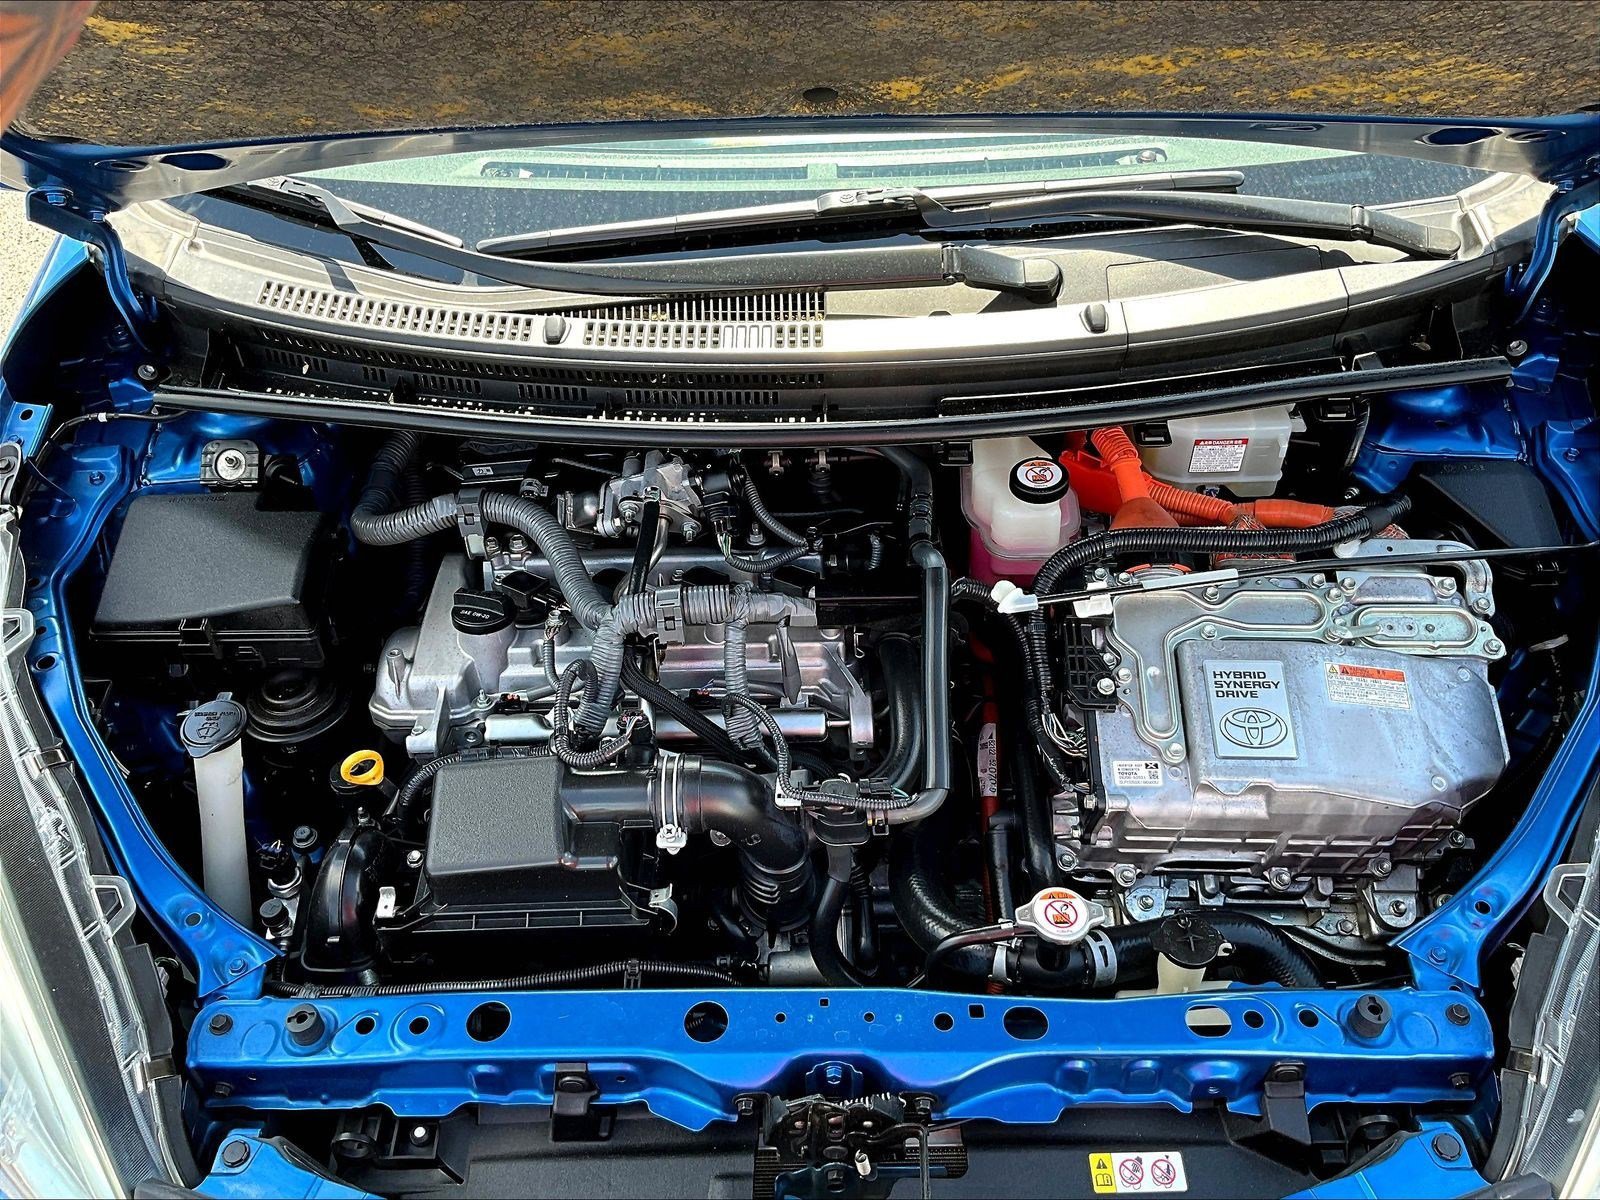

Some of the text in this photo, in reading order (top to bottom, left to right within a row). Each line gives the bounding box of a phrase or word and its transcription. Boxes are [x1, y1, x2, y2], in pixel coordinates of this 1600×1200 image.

[1212, 670, 1267, 679] HYBRID
[1213, 680, 1280, 689] SYNERGY
[1215, 690, 1259, 699] DRIVE
